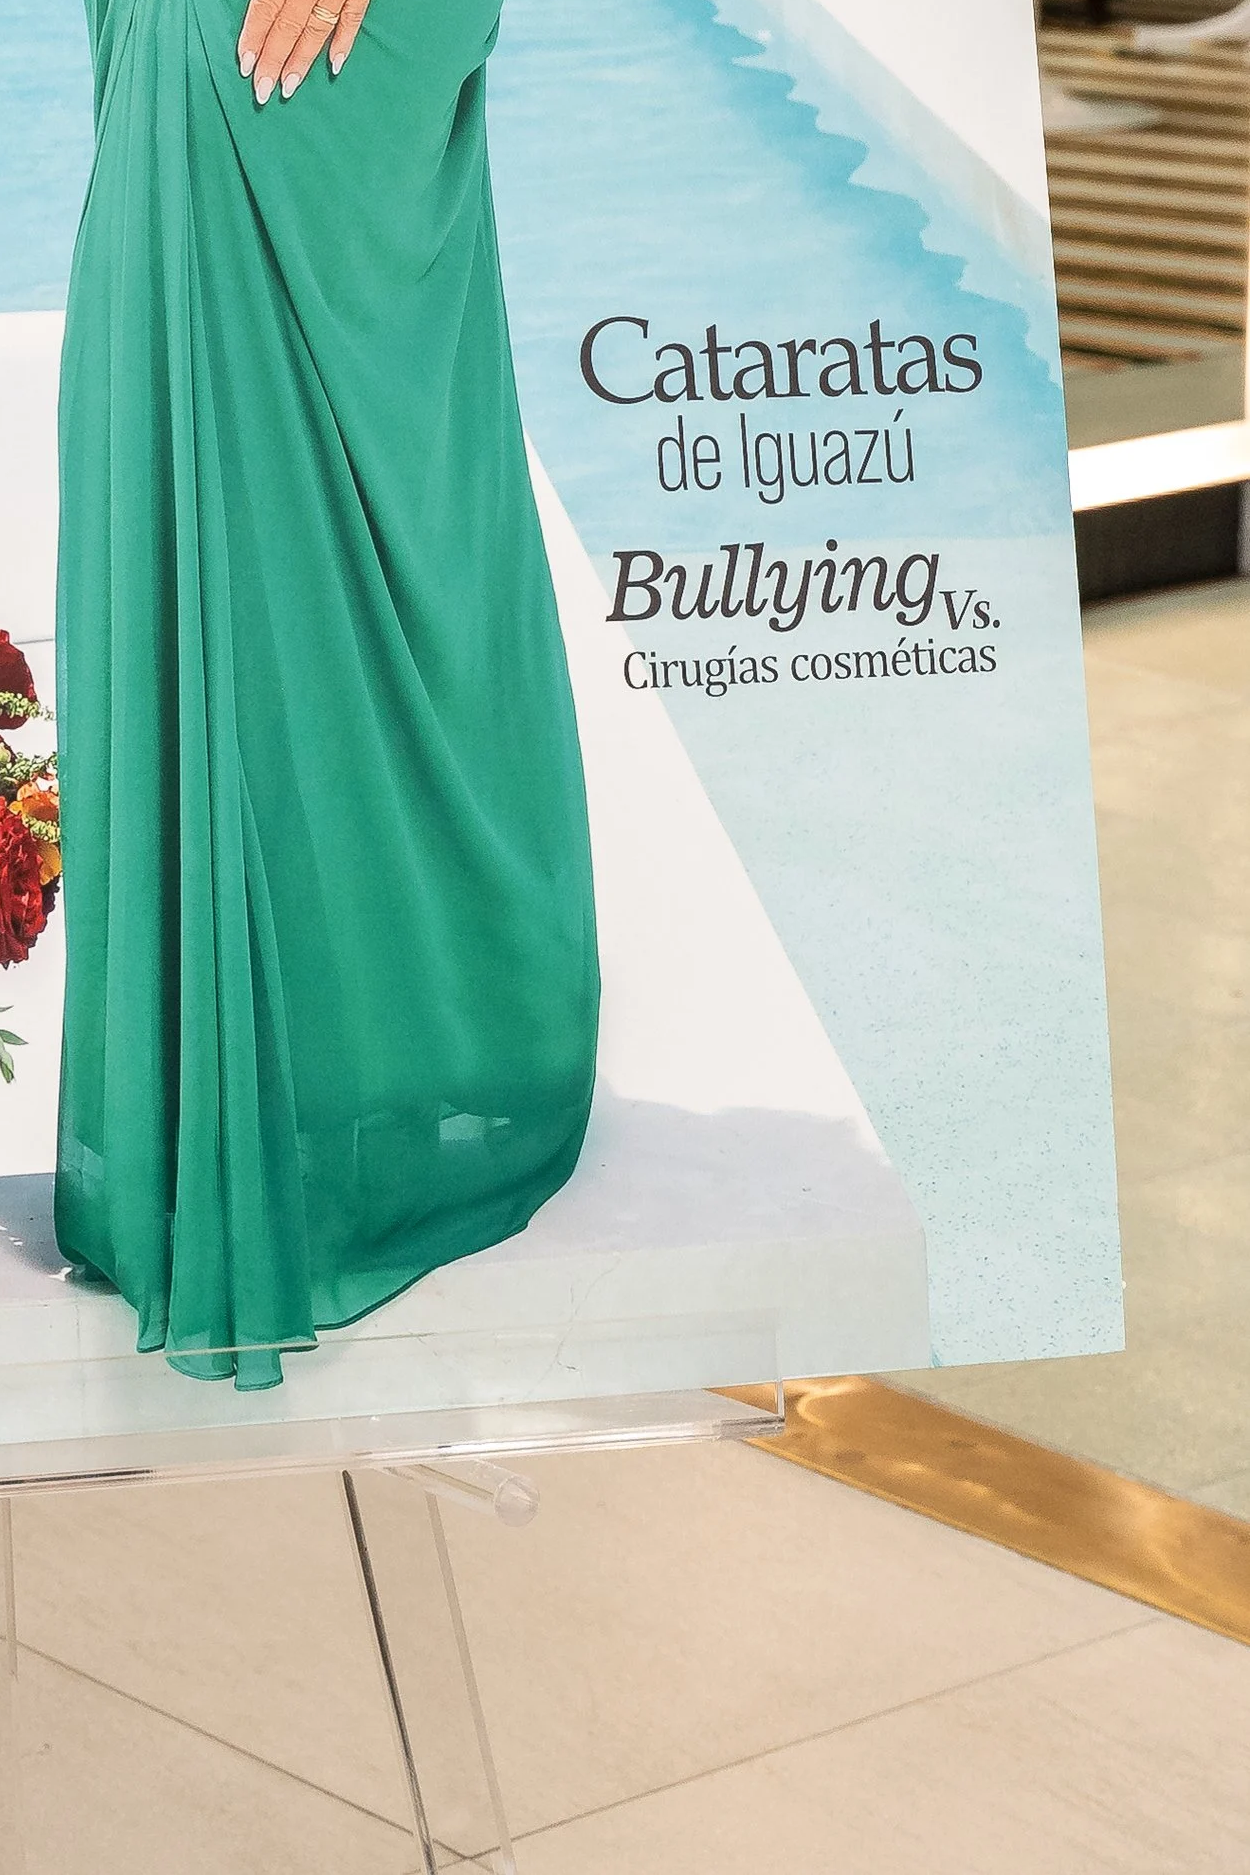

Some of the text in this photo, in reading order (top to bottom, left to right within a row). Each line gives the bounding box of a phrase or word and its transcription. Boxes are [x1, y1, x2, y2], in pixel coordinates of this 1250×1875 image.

[579, 316, 983, 405] Cataratas
[657, 408, 915, 505] de Iguazú
[605, 538, 1001, 633] Bullying Vs.
[623, 636, 997, 698] Cirugías cosméticas
